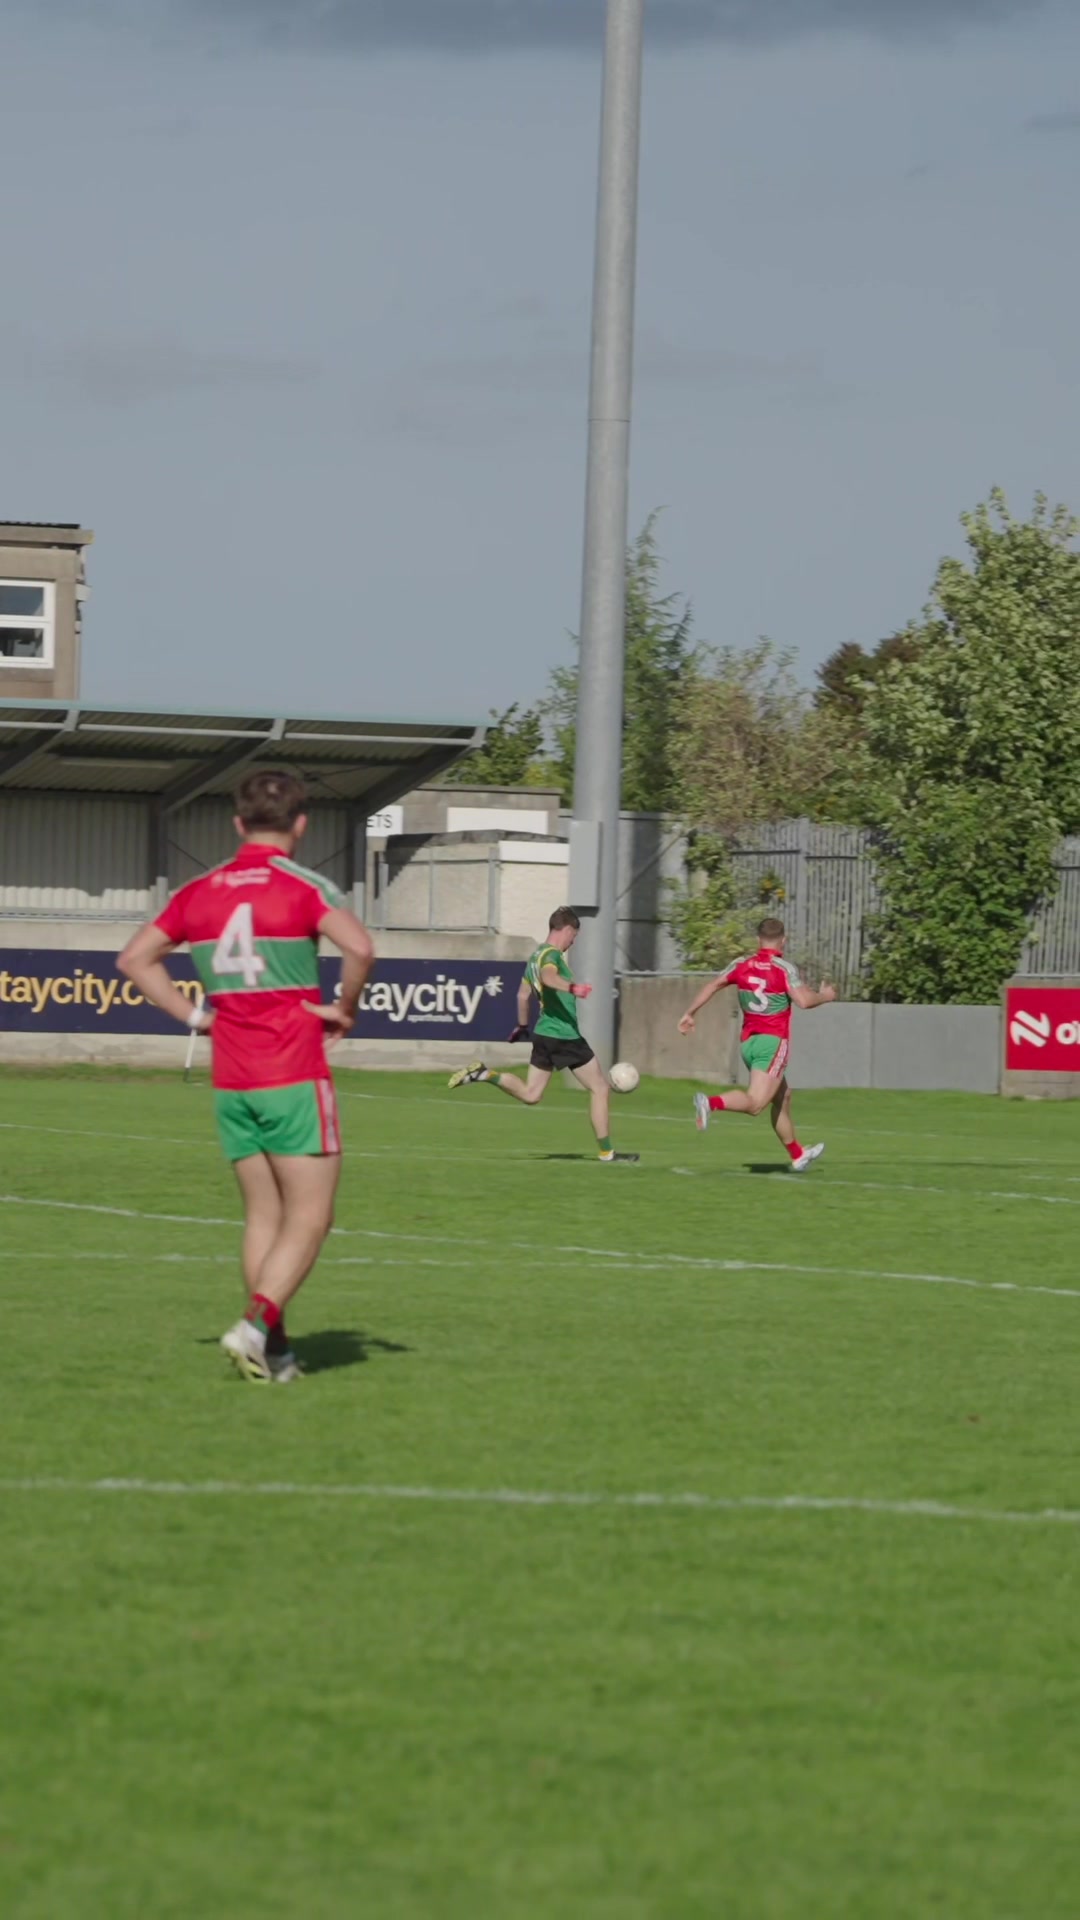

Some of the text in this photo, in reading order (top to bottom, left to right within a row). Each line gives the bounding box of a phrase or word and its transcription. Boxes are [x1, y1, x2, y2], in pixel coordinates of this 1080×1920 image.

[212, 901, 265, 987] 4
[0, 969, 204, 1015] taycity.cm
[747, 975, 769, 1012] 3
